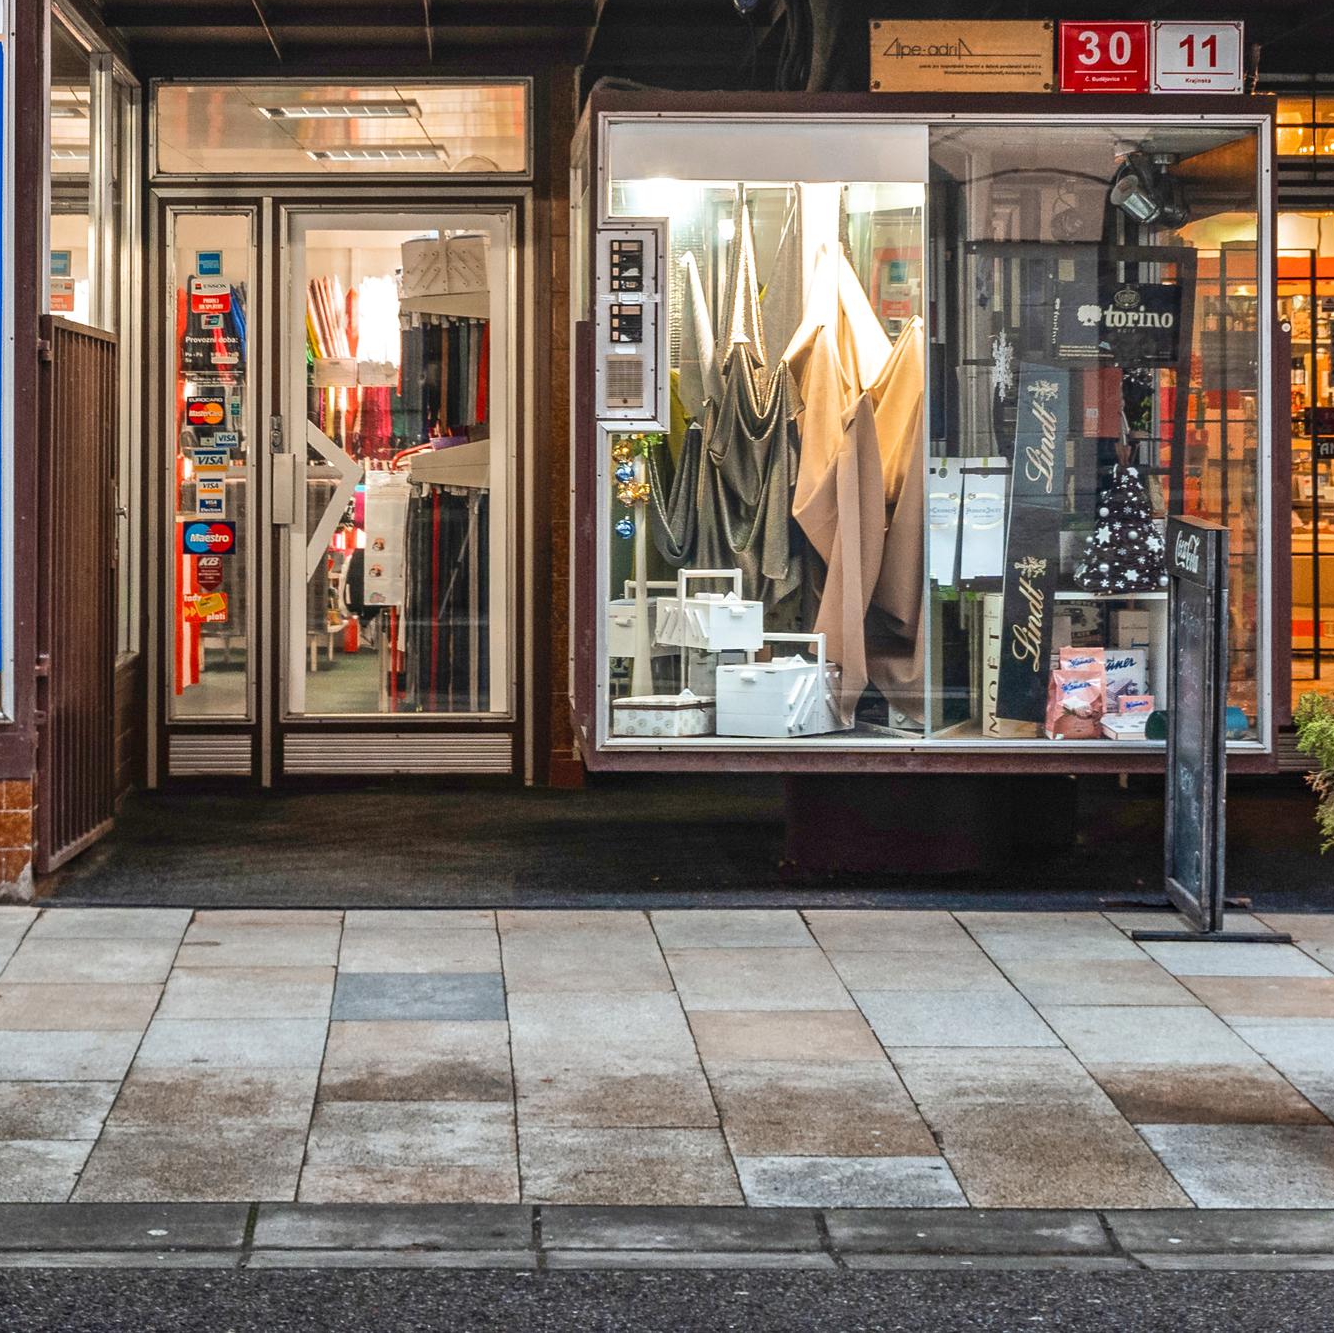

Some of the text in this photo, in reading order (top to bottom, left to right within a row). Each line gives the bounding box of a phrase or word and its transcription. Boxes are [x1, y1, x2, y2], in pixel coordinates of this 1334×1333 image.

[1077, 30, 1132, 66] 30
[1178, 34, 1217, 68] 11
[1104, 304, 1174, 328] torino
[197, 456, 224, 465] VISA
[1025, 400, 1057, 494] Lindt
[189, 533, 229, 543] Maestro
[198, 557, 220, 567] KB
[1012, 576, 1044, 673] Lindt
